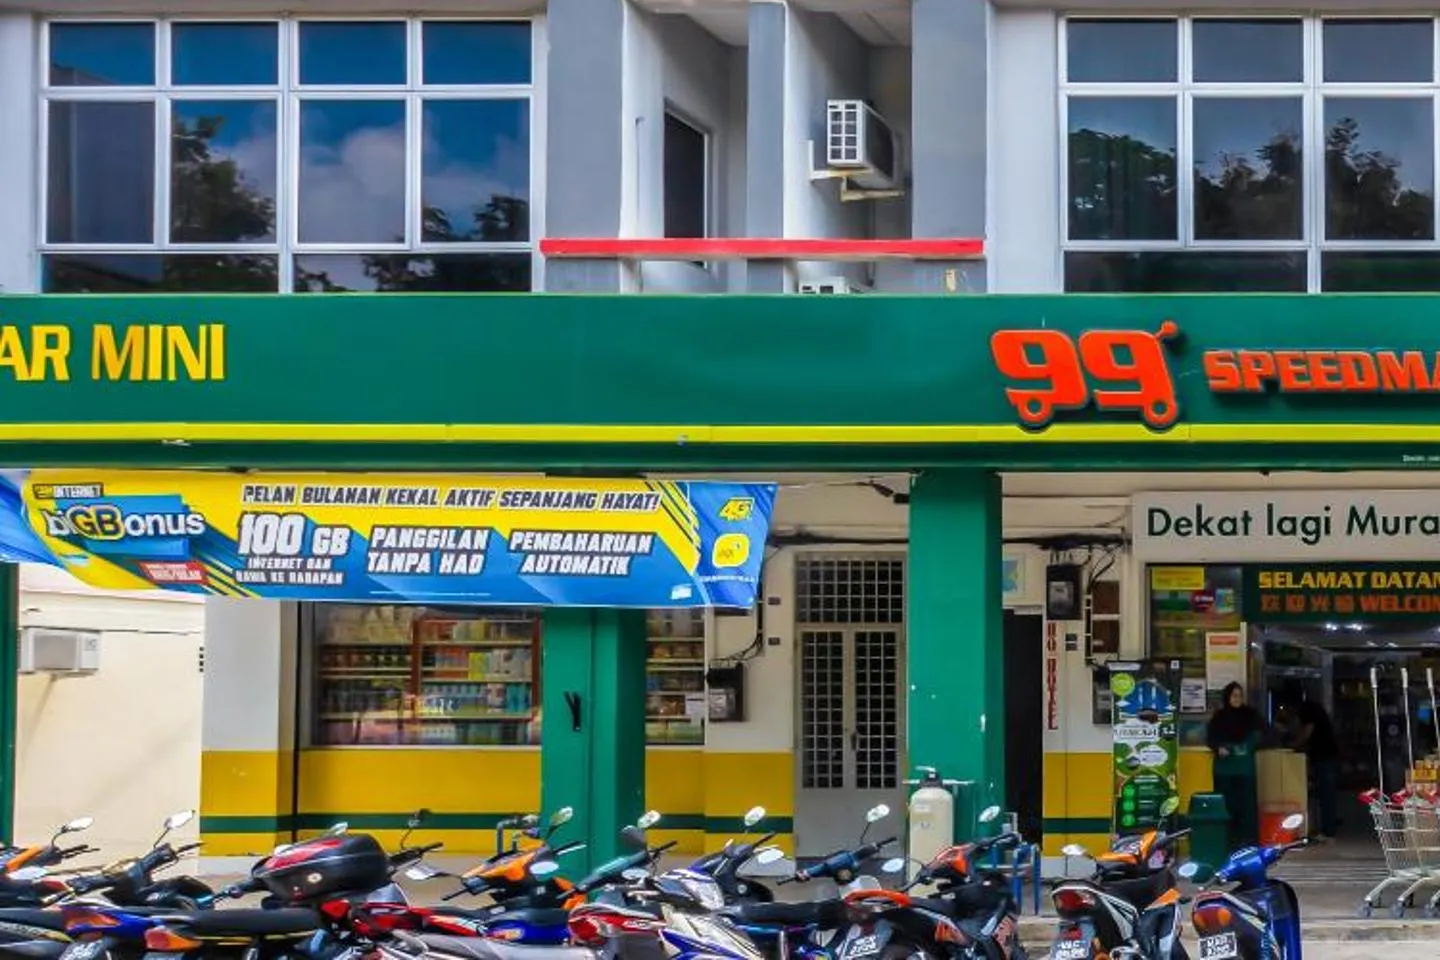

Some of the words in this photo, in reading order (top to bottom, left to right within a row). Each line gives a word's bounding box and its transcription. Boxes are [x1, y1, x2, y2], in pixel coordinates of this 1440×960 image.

[0, 324, 69, 381] AR
[91, 324, 225, 381] MINI
[991, 319, 1178, 426] 99
[243, 486, 296, 504] PELAN
[302, 487, 383, 505] BULANAN
[386, 488, 438, 506] KEKAL
[444, 489, 496, 507] AKTIF
[499, 491, 597, 509] SEPANJANG
[601, 493, 661, 511] HAYAT!
[238, 513, 306, 556] 100
[312, 526, 351, 556] GB
[1146, 505, 1252, 538] Dekat
[1266, 505, 1338, 545] lagi
[370, 526, 490, 551] PANGGILAN
[509, 531, 653, 555] PEMBAHARUAN
[248, 557, 304, 570] INTERNET
[367, 551, 432, 574] TANPA
[439, 552, 486, 575] HAD
[520, 554, 630, 576] AUTOMATIK
[1258, 571, 1365, 590] SELAMAT
